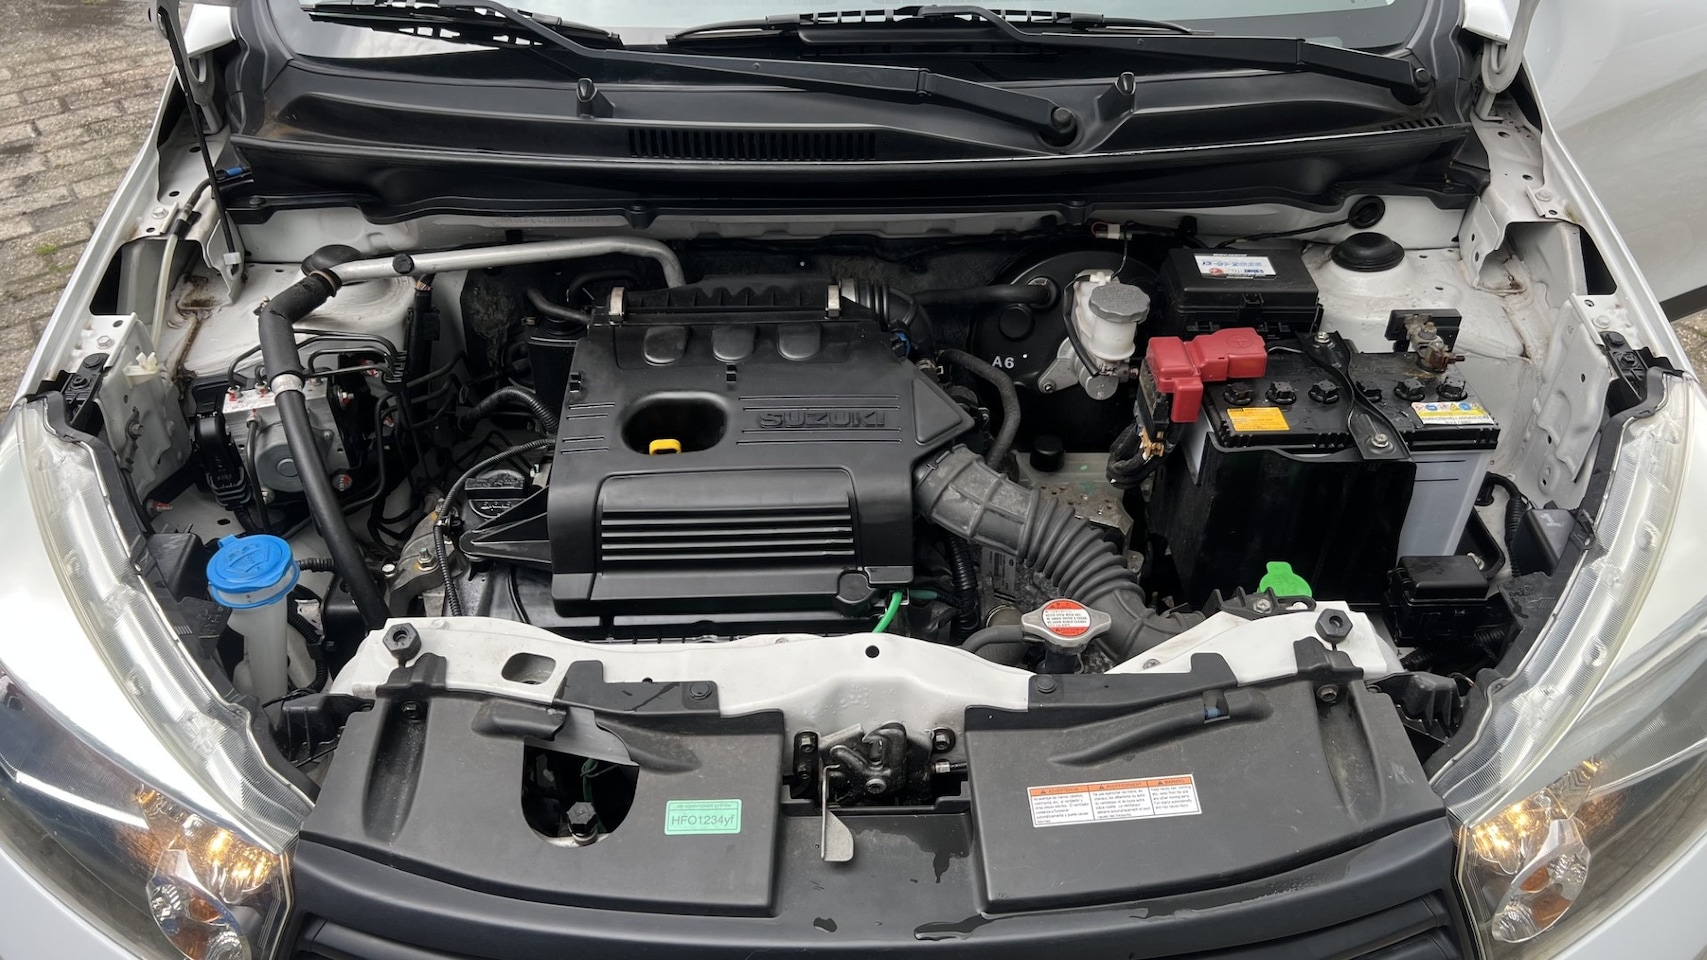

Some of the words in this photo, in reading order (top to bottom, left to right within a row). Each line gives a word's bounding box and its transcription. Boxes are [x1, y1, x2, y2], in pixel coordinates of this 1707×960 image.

[992, 355, 1015, 369] A6
[760, 411, 885, 429] SUZUKI
[671, 815, 734, 827] HFO1234yf
